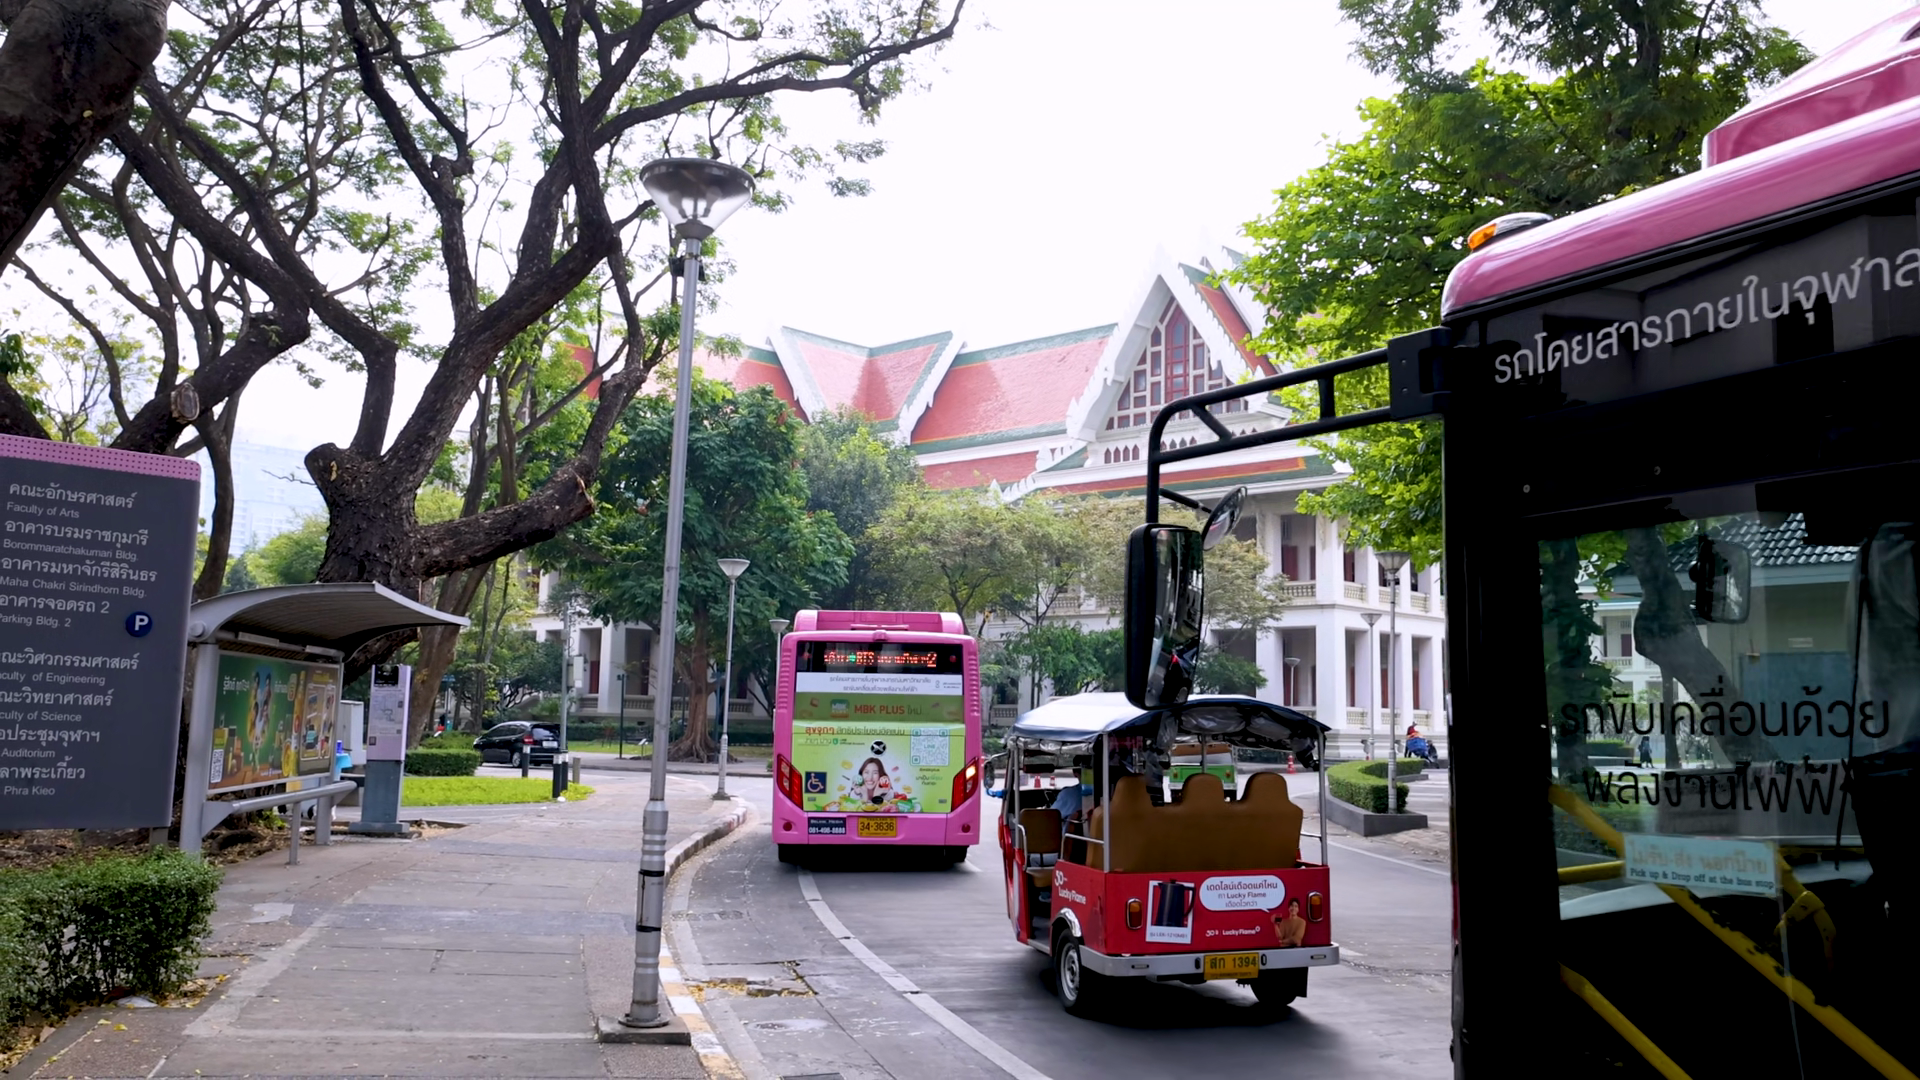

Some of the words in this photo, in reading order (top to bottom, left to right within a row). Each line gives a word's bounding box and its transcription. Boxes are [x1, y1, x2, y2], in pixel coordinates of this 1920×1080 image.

[9, 482, 137, 509] คณะอักษรศาสตร์
[7, 502, 43, 516] Faculty
[47, 507, 57, 516] of
[59, 508, 80, 518] Arts
[5, 520, 149, 548] อาคารบรมราชกุมารี
[4, 539, 113, 558] Borommaratchakumari
[115, 549, 139, 562] Bldg.
[1, 557, 158, 582] อาคารมหาจักรีสิรินธร
[0, 576, 29, 588] Maha
[32, 579, 66, 591] Chakri
[69, 582, 120, 595] Sirindhorn
[122, 586, 147, 598] Bldg.
[0, 594, 96, 613] อาคารจอดรถ
[100, 601, 110, 614] 2
[36, 616, 61, 629] Bldg.
[64, 618, 71, 627] 2
[134, 615, 149, 631] P
[0, 647, 140, 670] ณะวิศวกรรมศาสตร์
[0, 672, 26, 683] culty
[32, 672, 44, 682] of
[46, 673, 106, 686] Engineering
[0, 686, 114, 706] ณะวิทยาศาสตร์
[0, 711, 24, 722] culty
[27, 711, 38, 720] of
[41, 711, 82, 722] Science
[854, 705, 877, 715] MBK
[879, 705, 905, 715] PLUS
[1561, 675, 1890, 739] รถขับเคลื่อนด้วย
[0, 724, 100, 747] อประชุมจุฬาฯ
[1, 747, 56, 758] Auditorium
[0, 756, 86, 779] ลาพระเกี้ยว
[4, 785, 29, 796] Phra
[32, 785, 56, 796] Kieo
[1630, 868, 1646, 877] Pick
[1649, 871, 1659, 880] up
[1662, 871, 1668, 879] &
[1672, 871, 1691, 882] Drop
[1694, 874, 1706, 882] off
[1720, 875, 1733, 884] the
[1736, 877, 1752, 886] bus
[1755, 880, 1774, 890] stop
[1232, 956, 1257, 968] 1394
